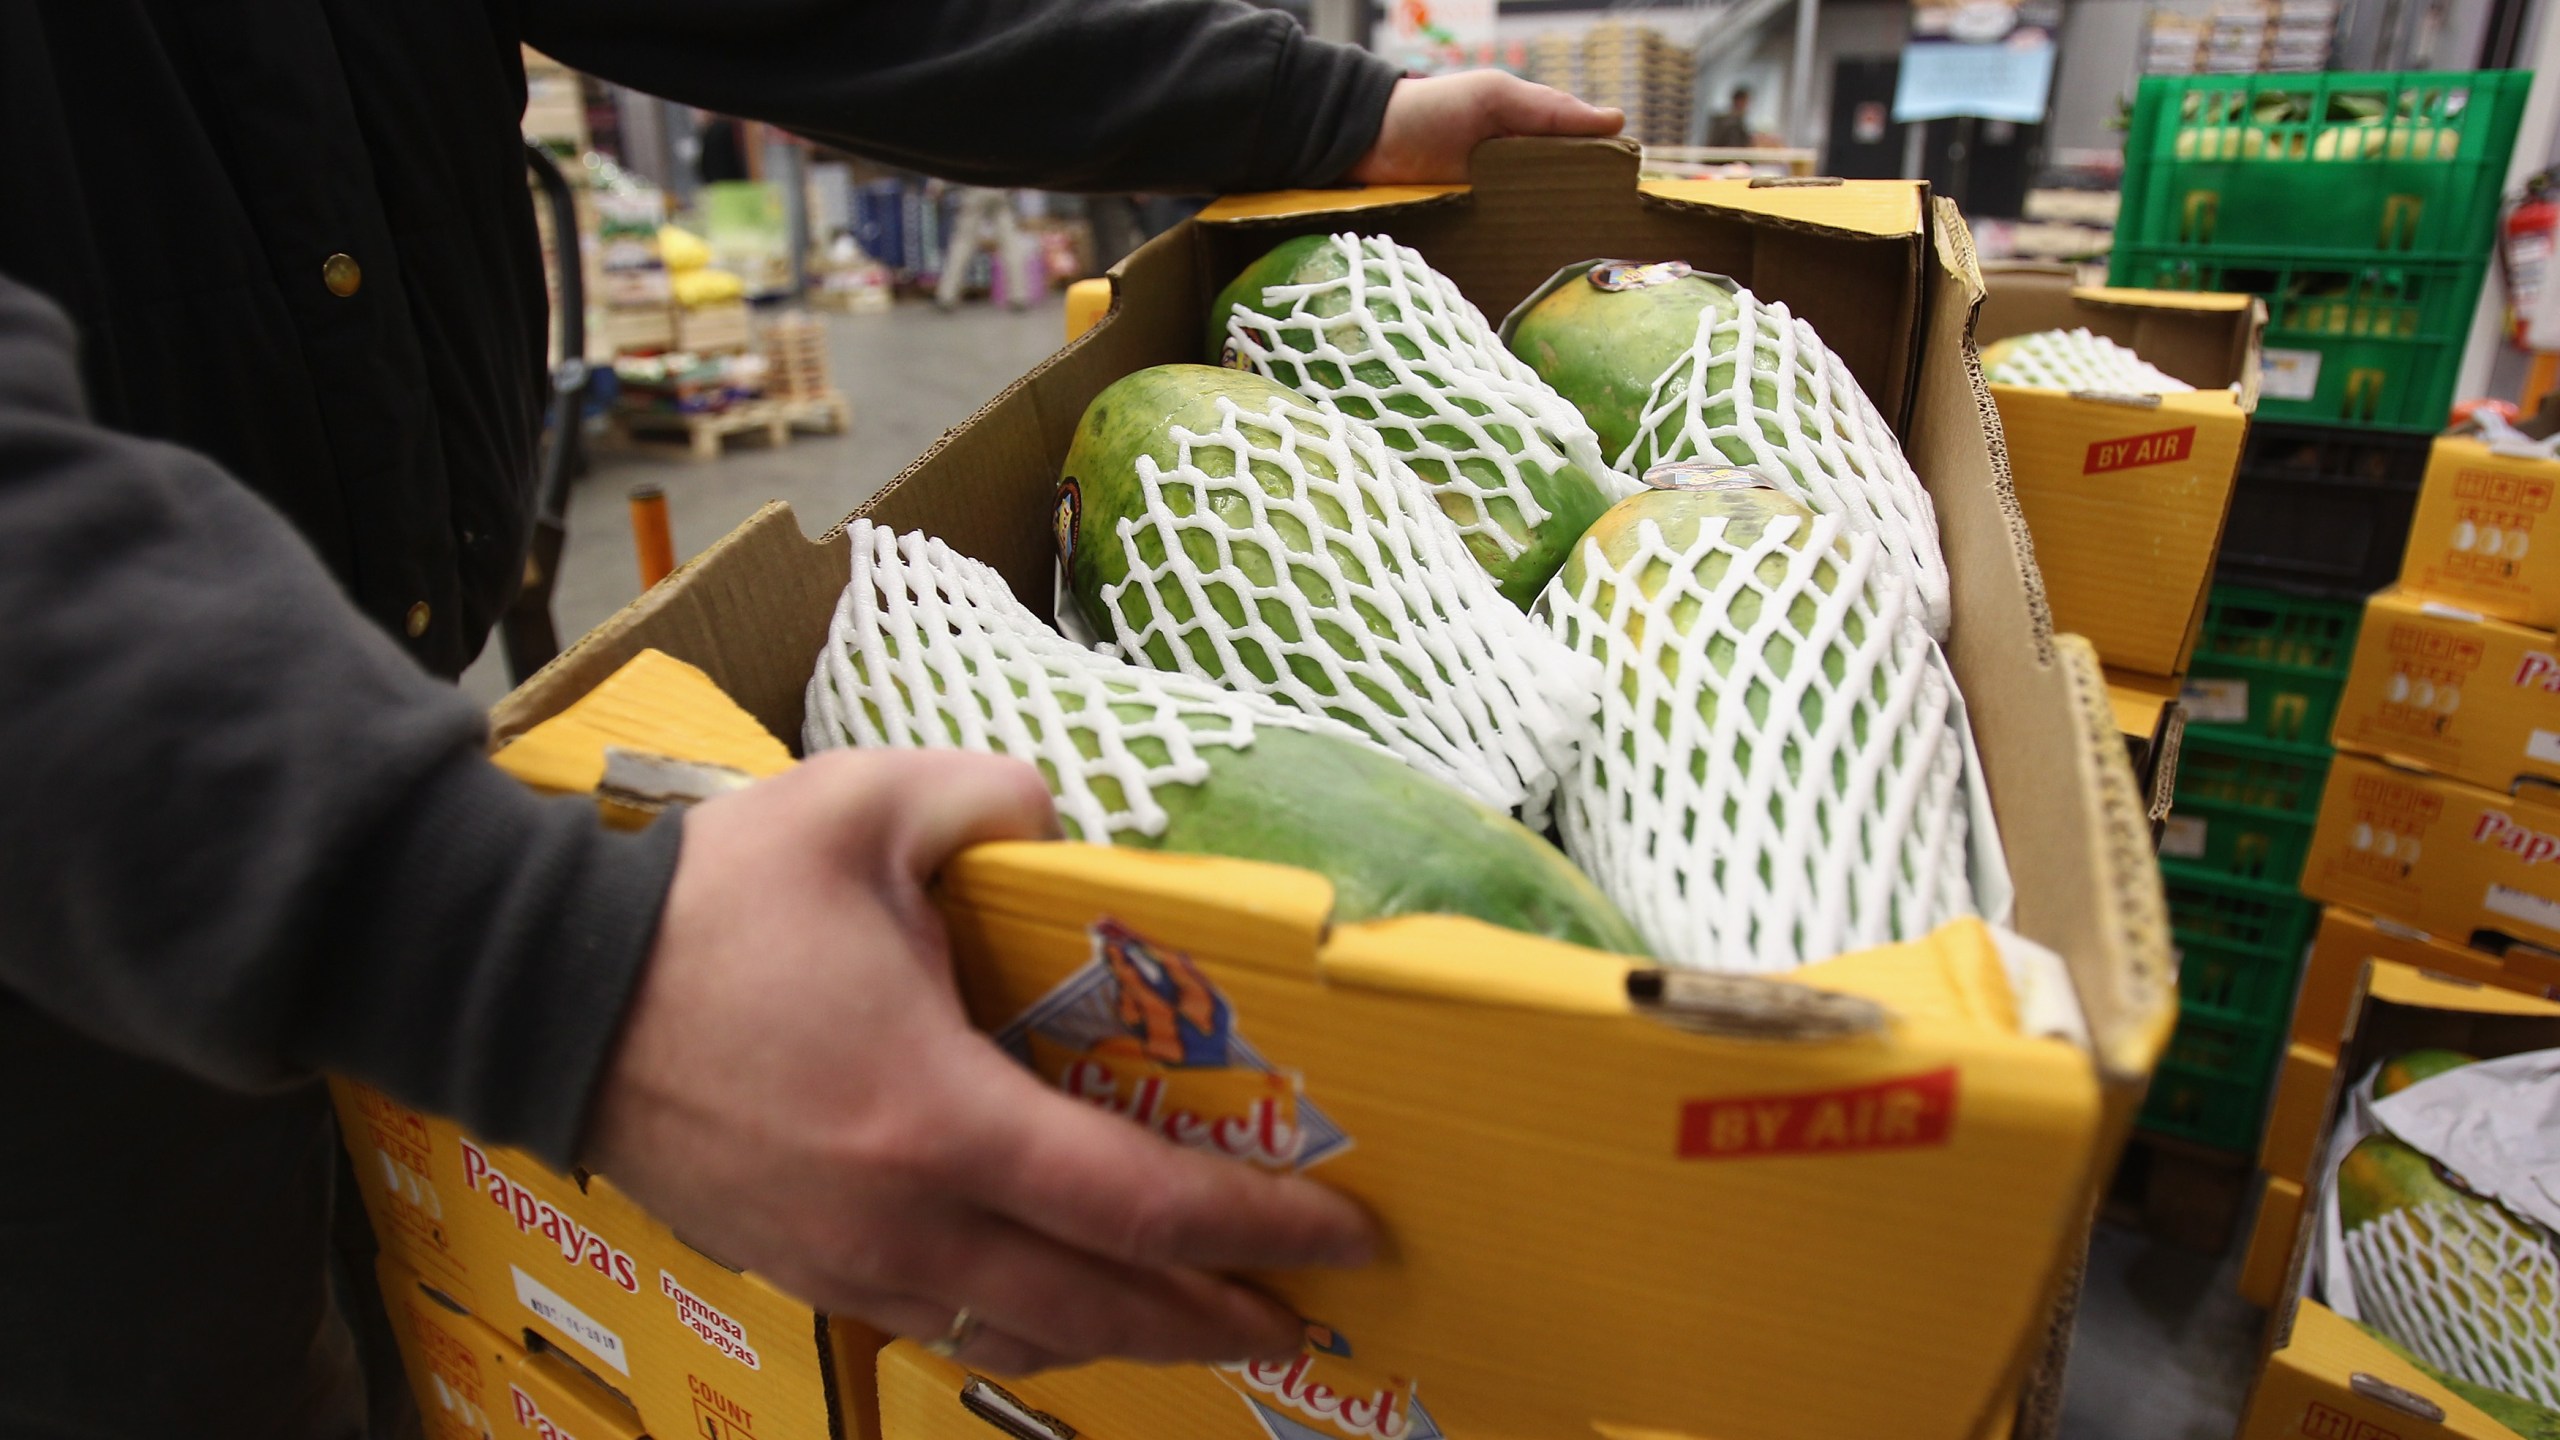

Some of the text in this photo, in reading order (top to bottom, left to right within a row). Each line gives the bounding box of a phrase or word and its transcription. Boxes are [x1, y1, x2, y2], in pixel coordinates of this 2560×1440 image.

[2098, 434, 2179, 468] BY AIR
[2471, 813, 2560, 864] Pap
[1708, 1090, 1922, 1151] BY AIR
[460, 1140, 638, 1293] Papayas
[662, 1276, 742, 1341] Formosa
[679, 1305, 756, 1366] Papayas
[687, 1373, 753, 1431] COUNT
[1247, 1353, 1411, 1439] elect
